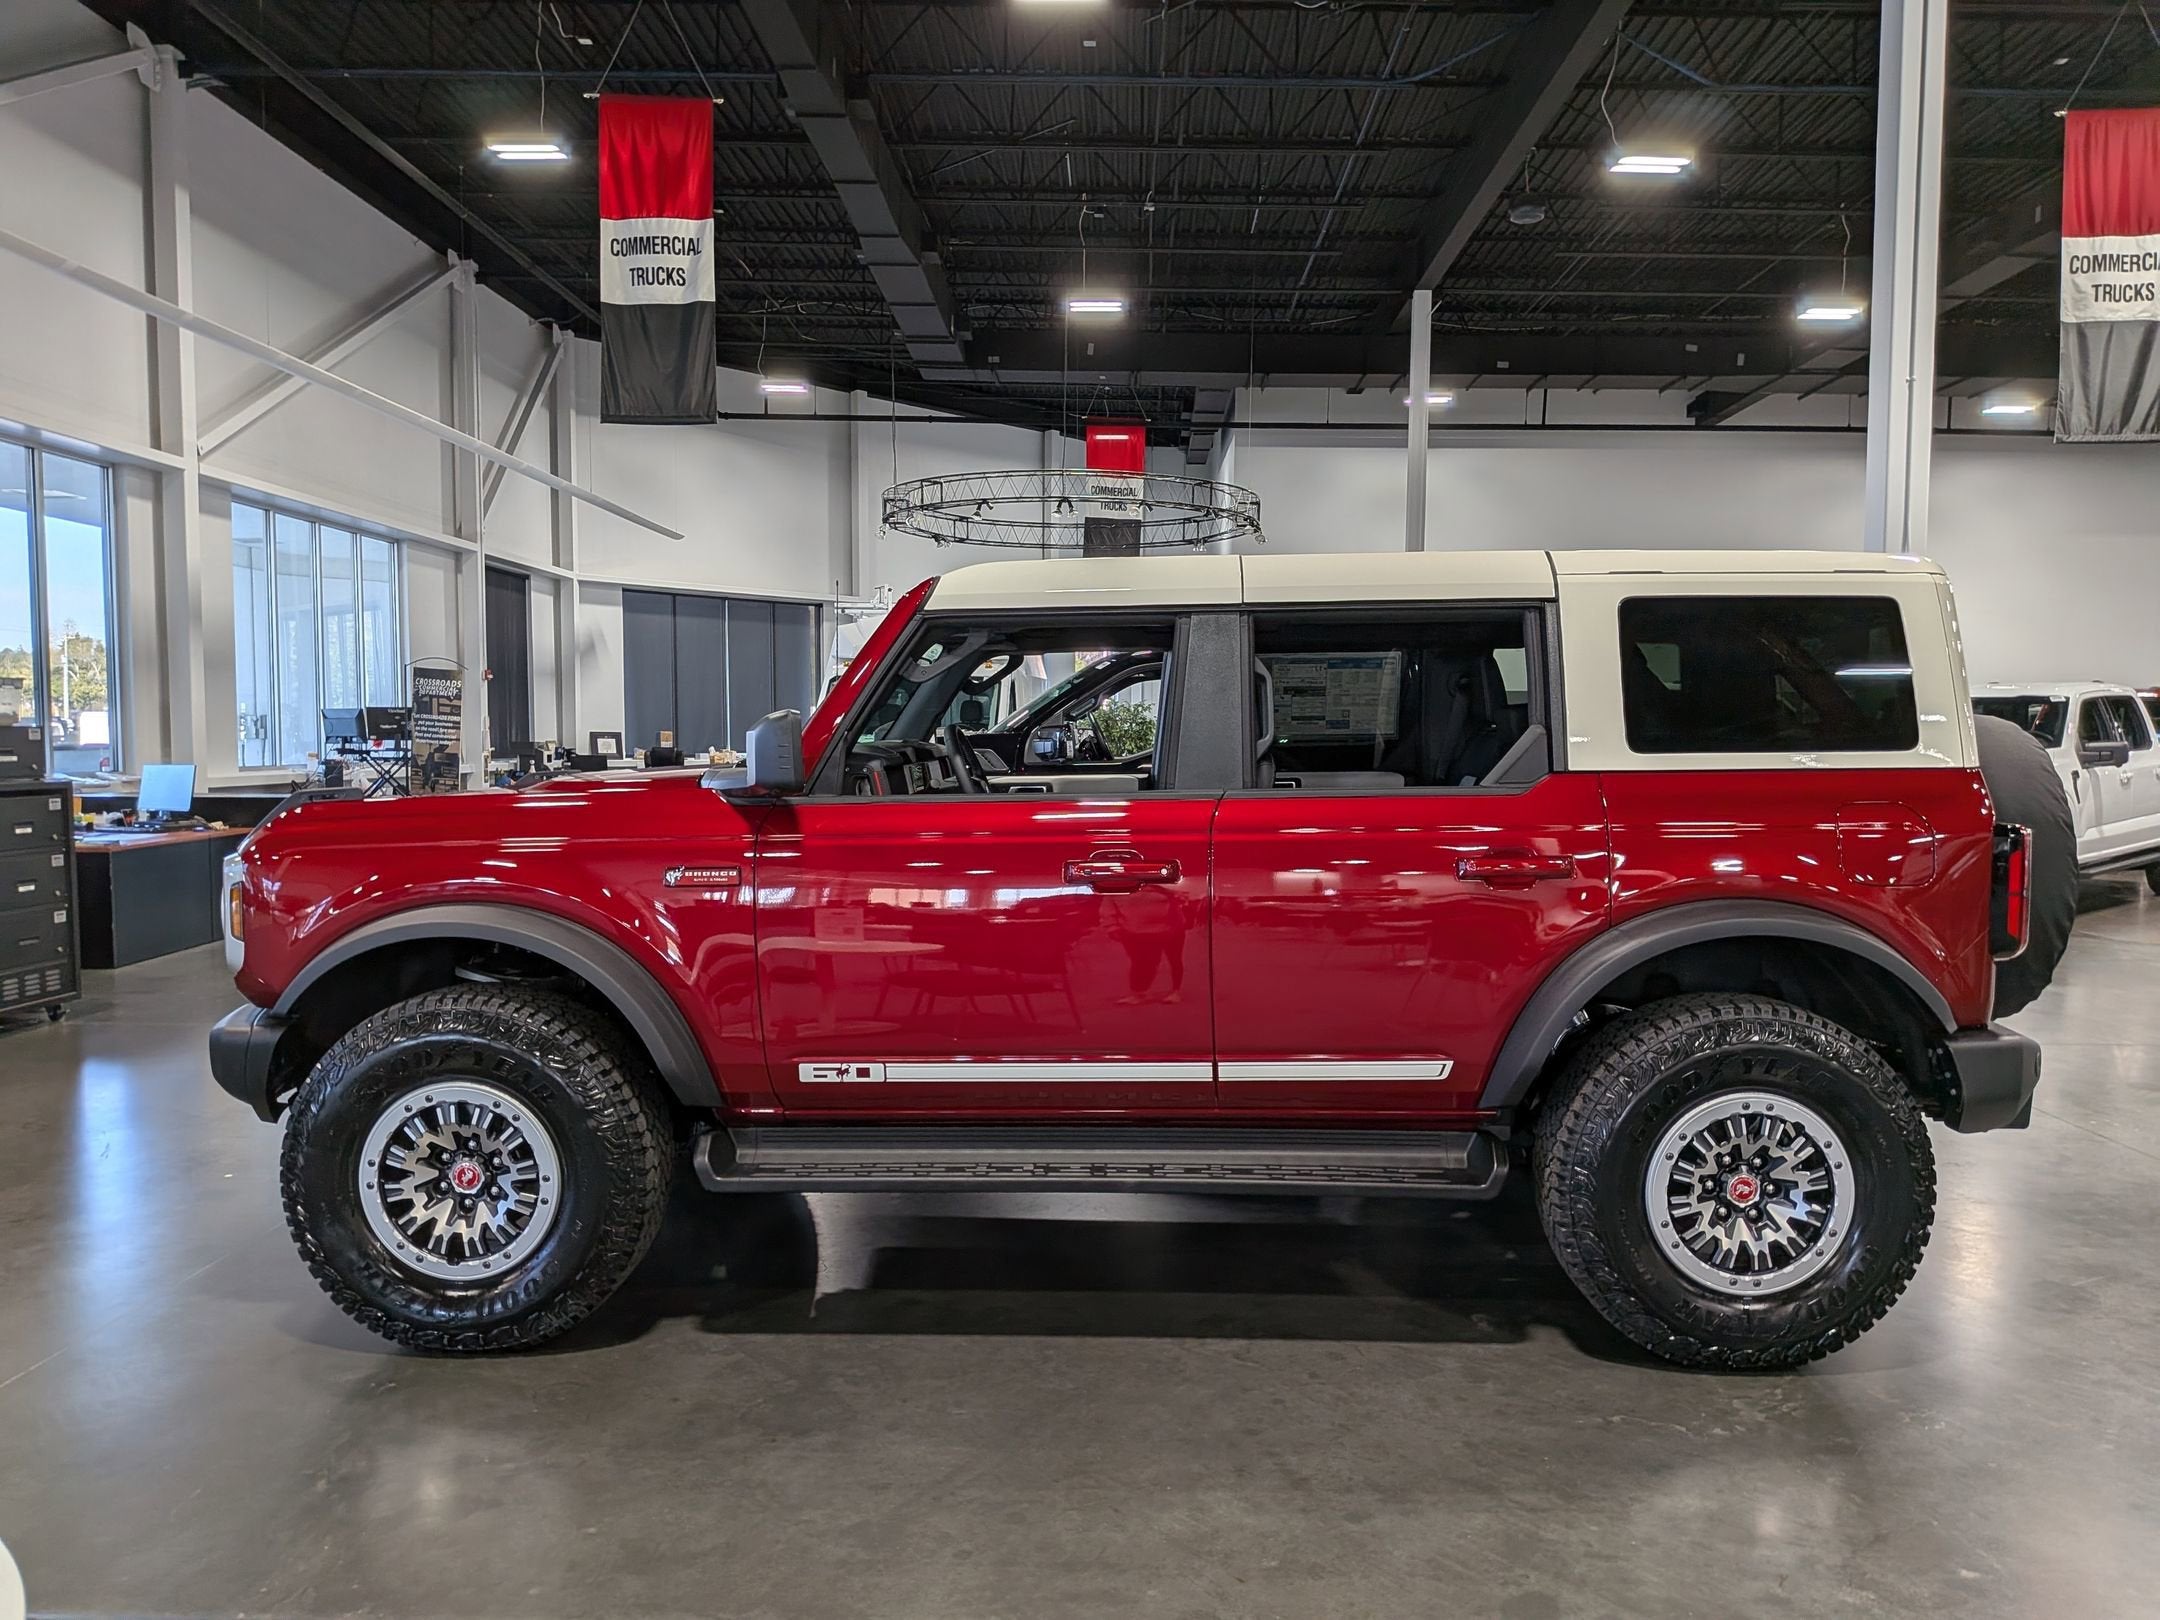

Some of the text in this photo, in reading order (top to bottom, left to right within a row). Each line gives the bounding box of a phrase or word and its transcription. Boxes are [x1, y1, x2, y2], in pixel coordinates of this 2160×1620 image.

[610, 235, 702, 257] COMMERCIAL
[2069, 252, 2160, 274] COMMERCI
[629, 266, 686, 286] TRUCKS
[2091, 282, 2155, 302] TRUCKS
[1090, 485, 1137, 497] COMMERCIAL
[1100, 501, 1127, 511] TRUCKS
[415, 678, 462, 688] CROSSROADS
